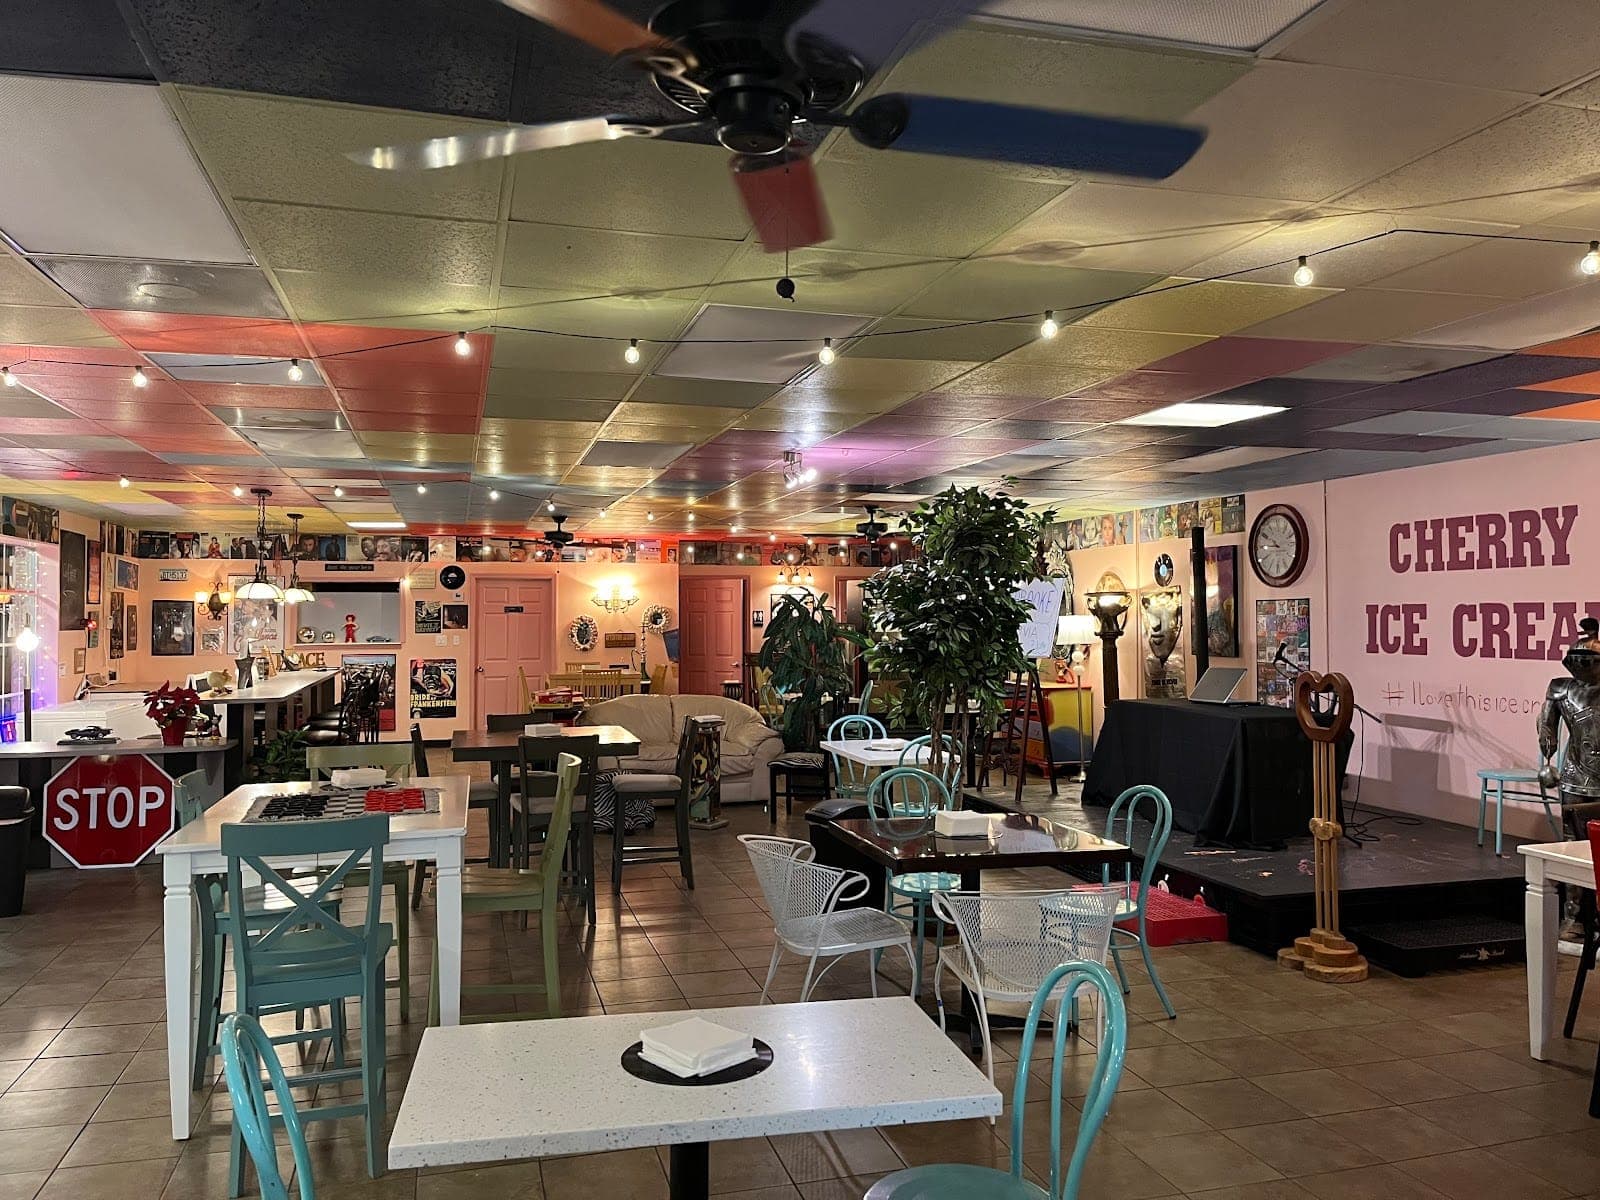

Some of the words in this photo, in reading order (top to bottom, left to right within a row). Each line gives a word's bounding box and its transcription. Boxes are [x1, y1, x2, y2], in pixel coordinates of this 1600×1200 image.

[1389, 504, 1579, 574] CHERRY
[1366, 603, 1428, 656] ICE
[53, 786, 166, 831] STOP
